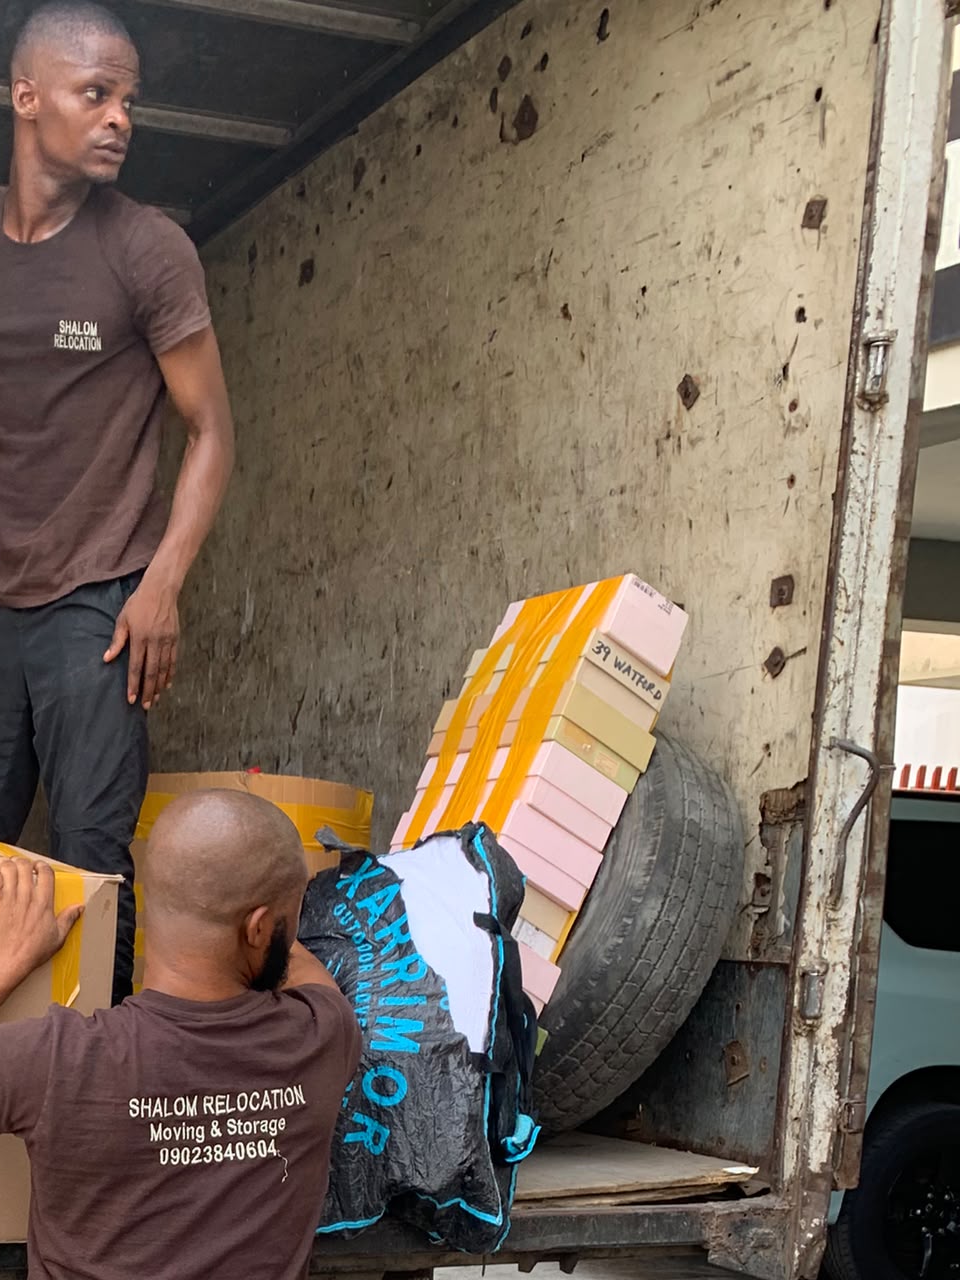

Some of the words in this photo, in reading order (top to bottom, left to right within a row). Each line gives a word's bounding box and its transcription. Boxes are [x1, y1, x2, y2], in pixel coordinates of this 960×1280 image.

[59, 320, 98, 336] SHALOM
[54, 334, 102, 351] RELOCATION
[591, 640, 612, 662] 39
[333, 902, 375, 974] OUTDOOR
[128, 1096, 199, 1118] SHALOM
[203, 1085, 307, 1116] RELOCATION
[150, 1122, 205, 1143] Moving
[210, 1120, 223, 1138] &
[226, 1117, 287, 1137] Storage
[159, 1139, 278, 1166] 09023840604
